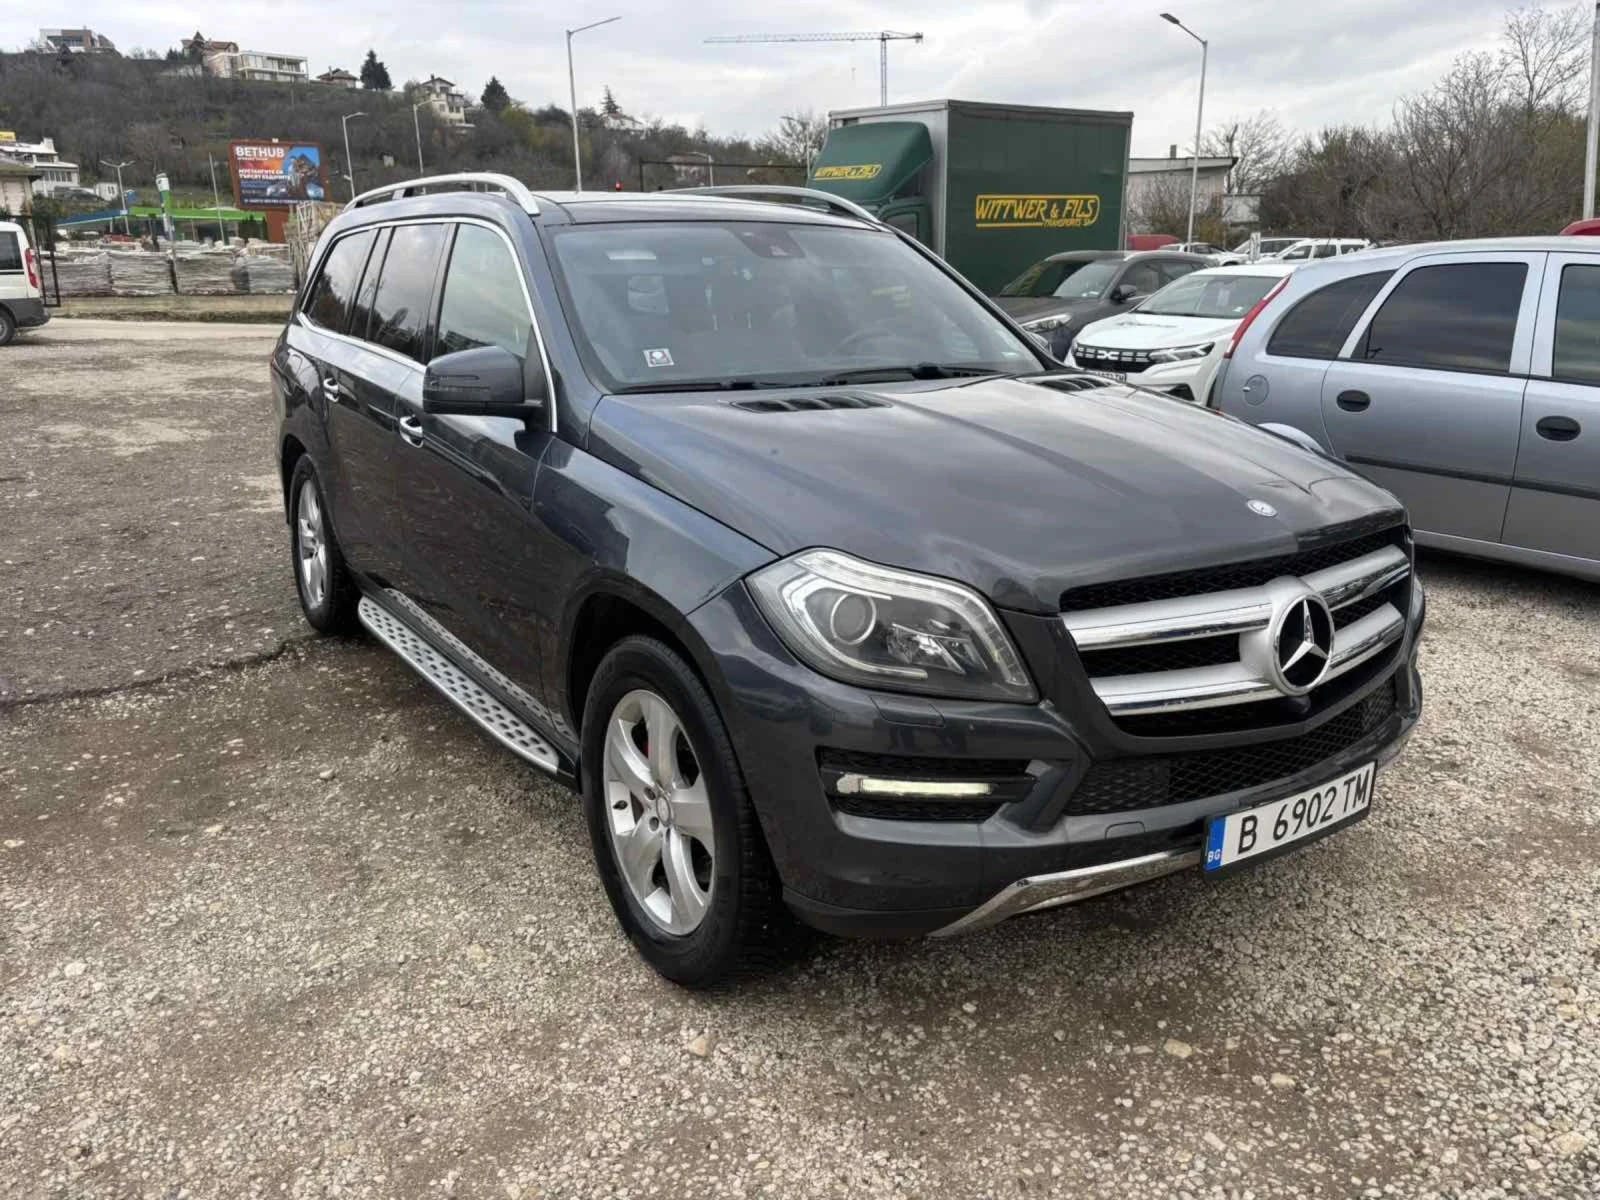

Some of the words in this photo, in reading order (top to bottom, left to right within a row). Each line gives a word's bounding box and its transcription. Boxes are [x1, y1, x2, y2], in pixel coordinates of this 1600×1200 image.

[236, 146, 285, 158] BETHUB
[976, 199, 1047, 220] WITTWER
[1050, 203, 1059, 218] &
[1062, 199, 1095, 218] FILS
[1237, 814, 1258, 855] B
[1273, 786, 1337, 841] 6902
[1343, 769, 1370, 813] TM
[1207, 849, 1220, 862] BG
